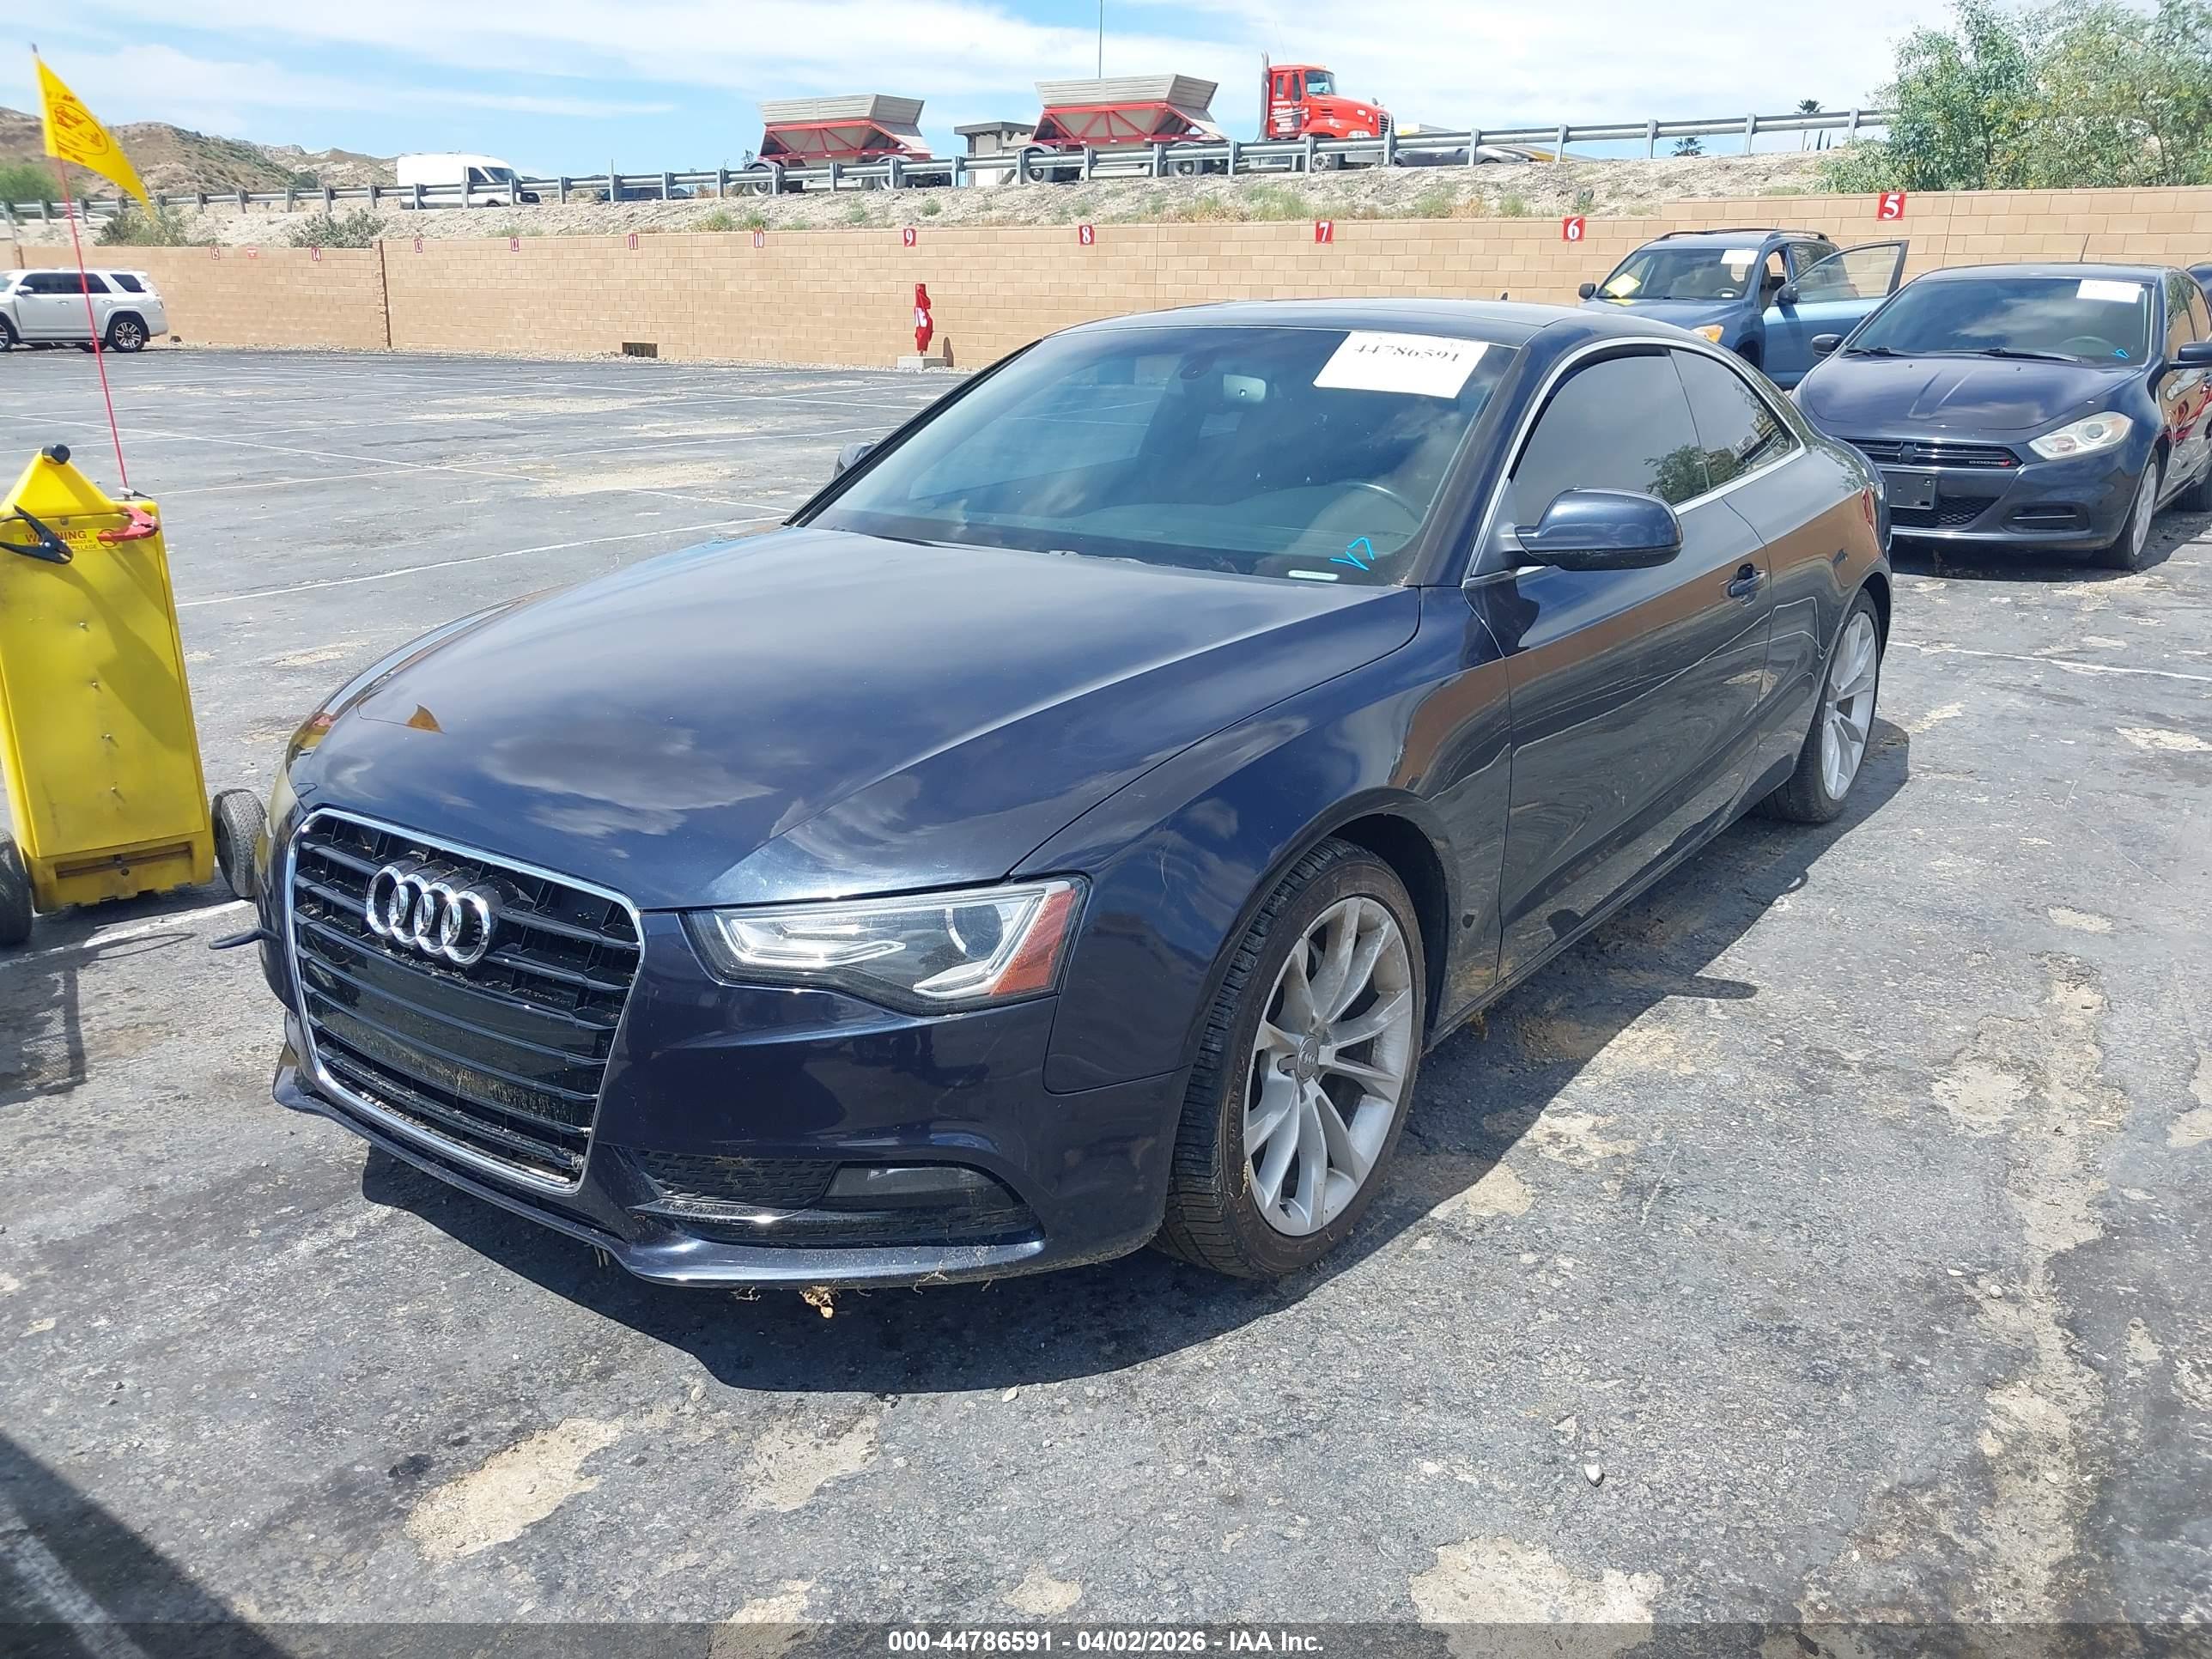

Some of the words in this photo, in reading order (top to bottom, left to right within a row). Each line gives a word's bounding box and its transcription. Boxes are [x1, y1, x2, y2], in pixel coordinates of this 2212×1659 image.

[1883, 194, 1900, 218] 5
[906, 229, 914, 246] 9
[1081, 226, 1091, 245] 8
[1319, 222, 1329, 243] 7
[1567, 218, 1580, 240] 6
[629, 235, 637, 249] 11
[755, 232, 763, 247] 10
[211, 248, 219, 259] 15
[313, 247, 320, 261] 14
